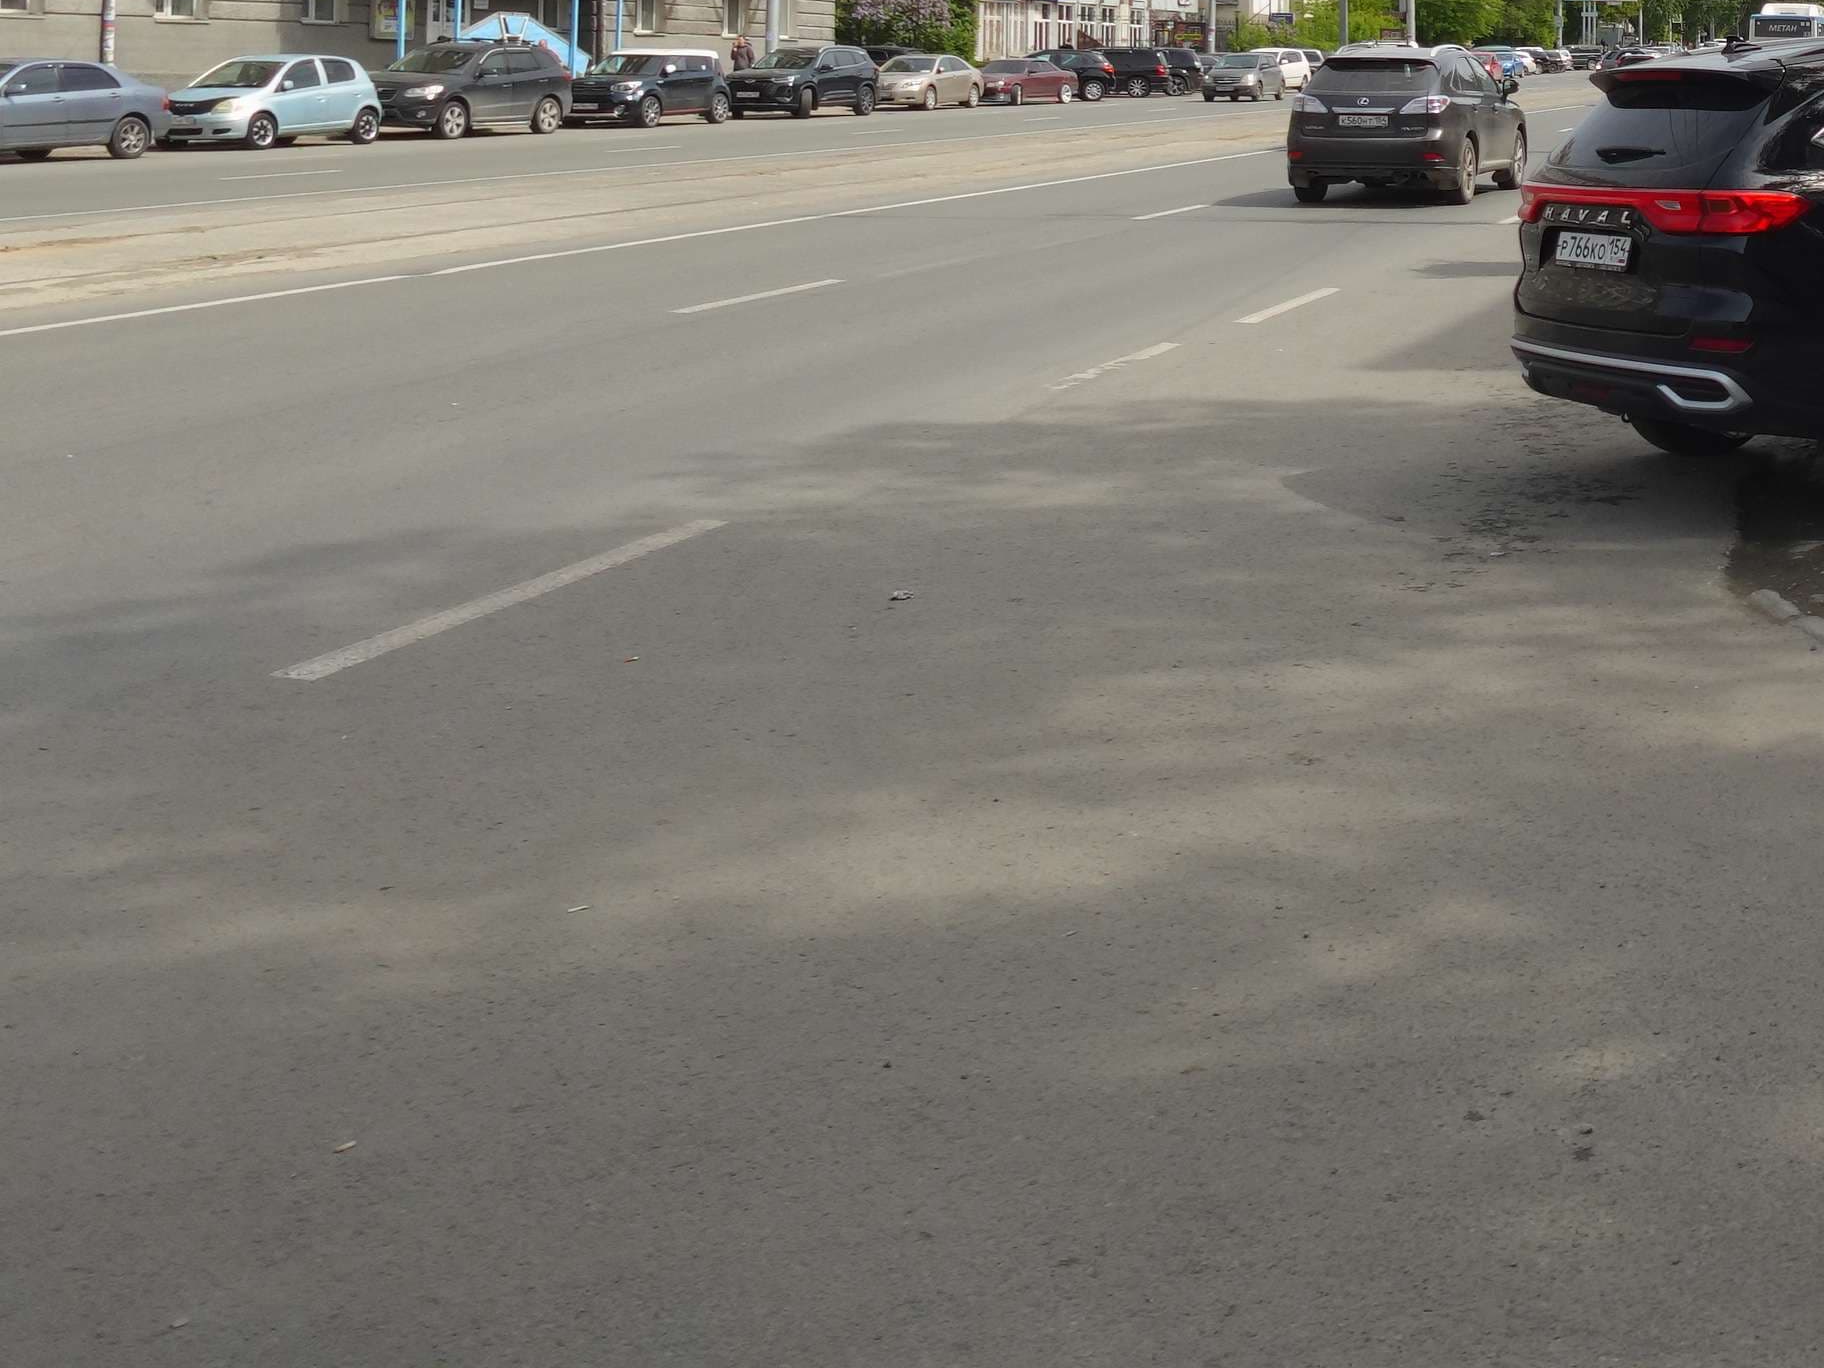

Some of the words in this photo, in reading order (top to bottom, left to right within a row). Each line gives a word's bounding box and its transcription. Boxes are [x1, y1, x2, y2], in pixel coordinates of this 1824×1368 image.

[1768, 24, 1798, 33] МЕТАН
[1543, 207, 1632, 225] HAVAL
[1560, 236, 1606, 260] Р766КО
[1608, 238, 1627, 257] 154
